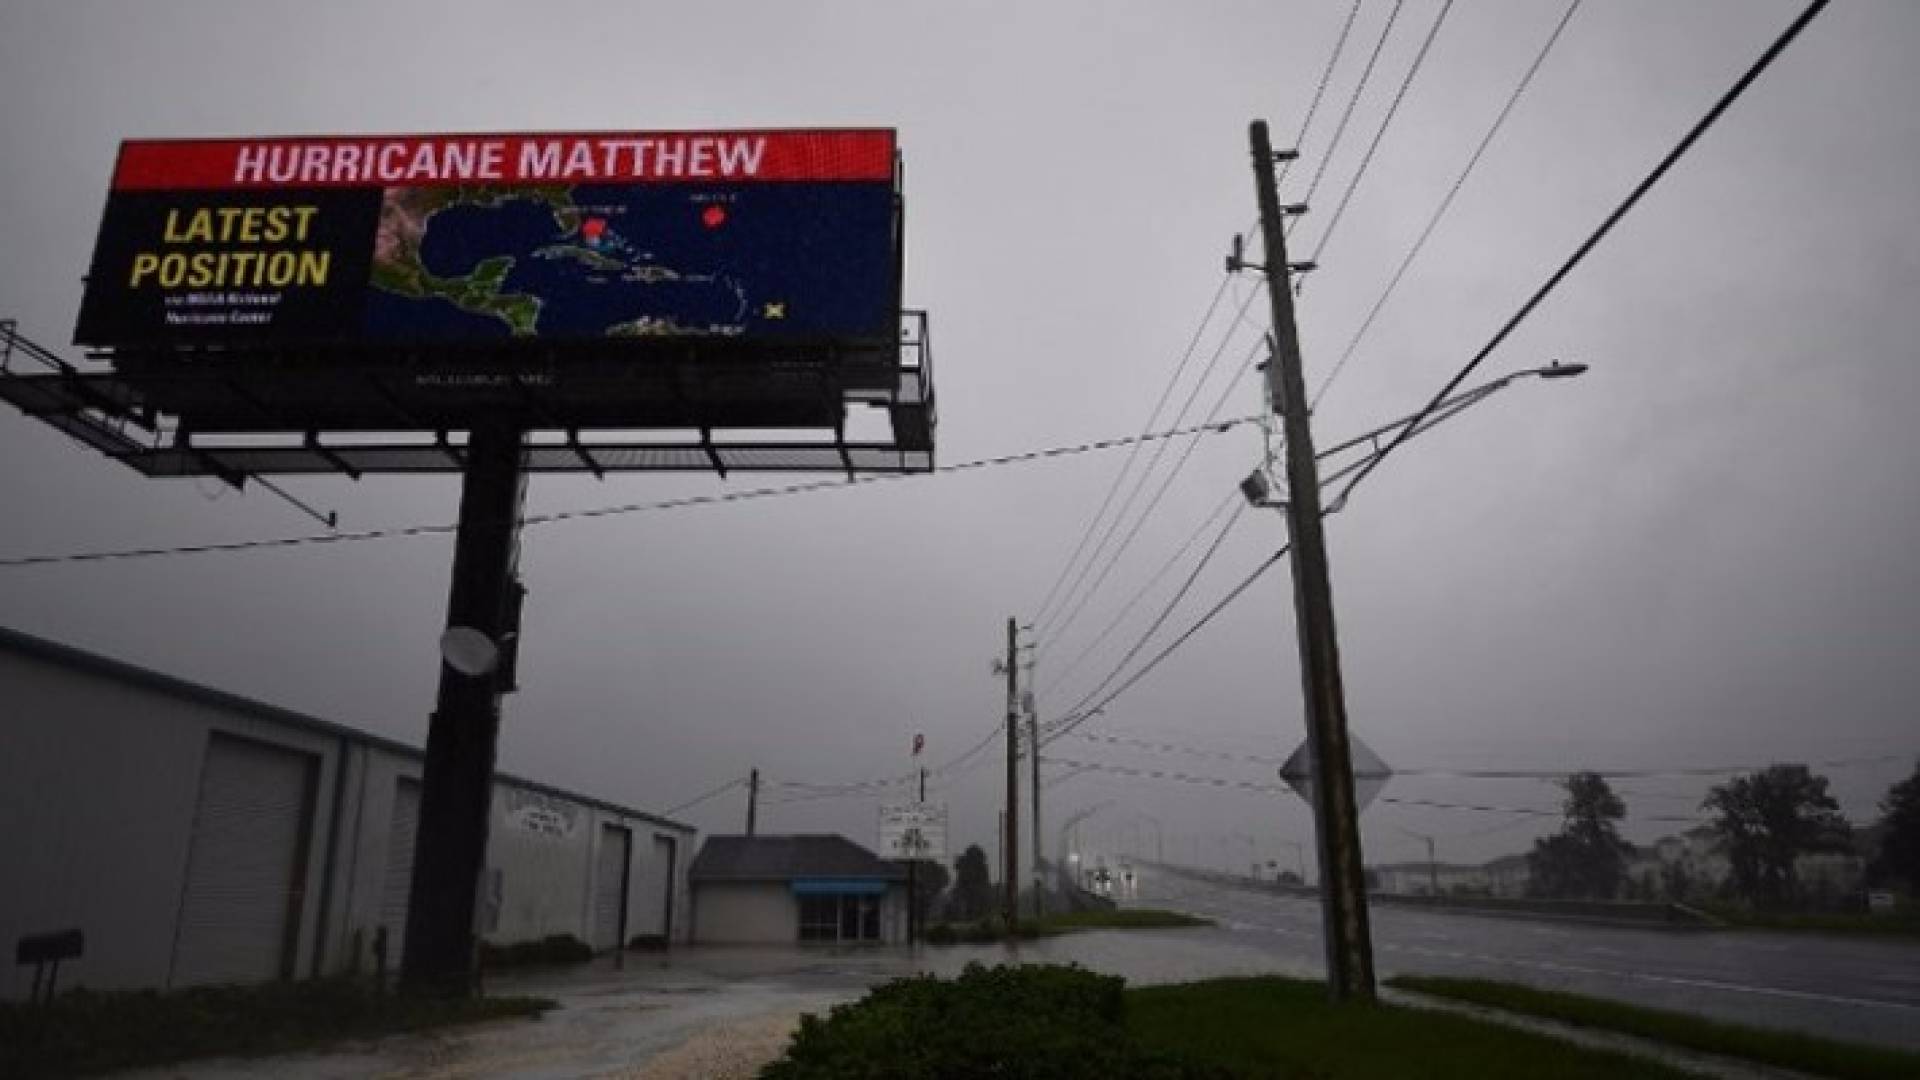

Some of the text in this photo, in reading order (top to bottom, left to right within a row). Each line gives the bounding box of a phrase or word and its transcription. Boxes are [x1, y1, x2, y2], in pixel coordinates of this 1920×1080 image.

[234, 138, 765, 184] HURRICANE MATTHEW
[163, 207, 319, 242] LATEST
[129, 252, 331, 288] POSITION
